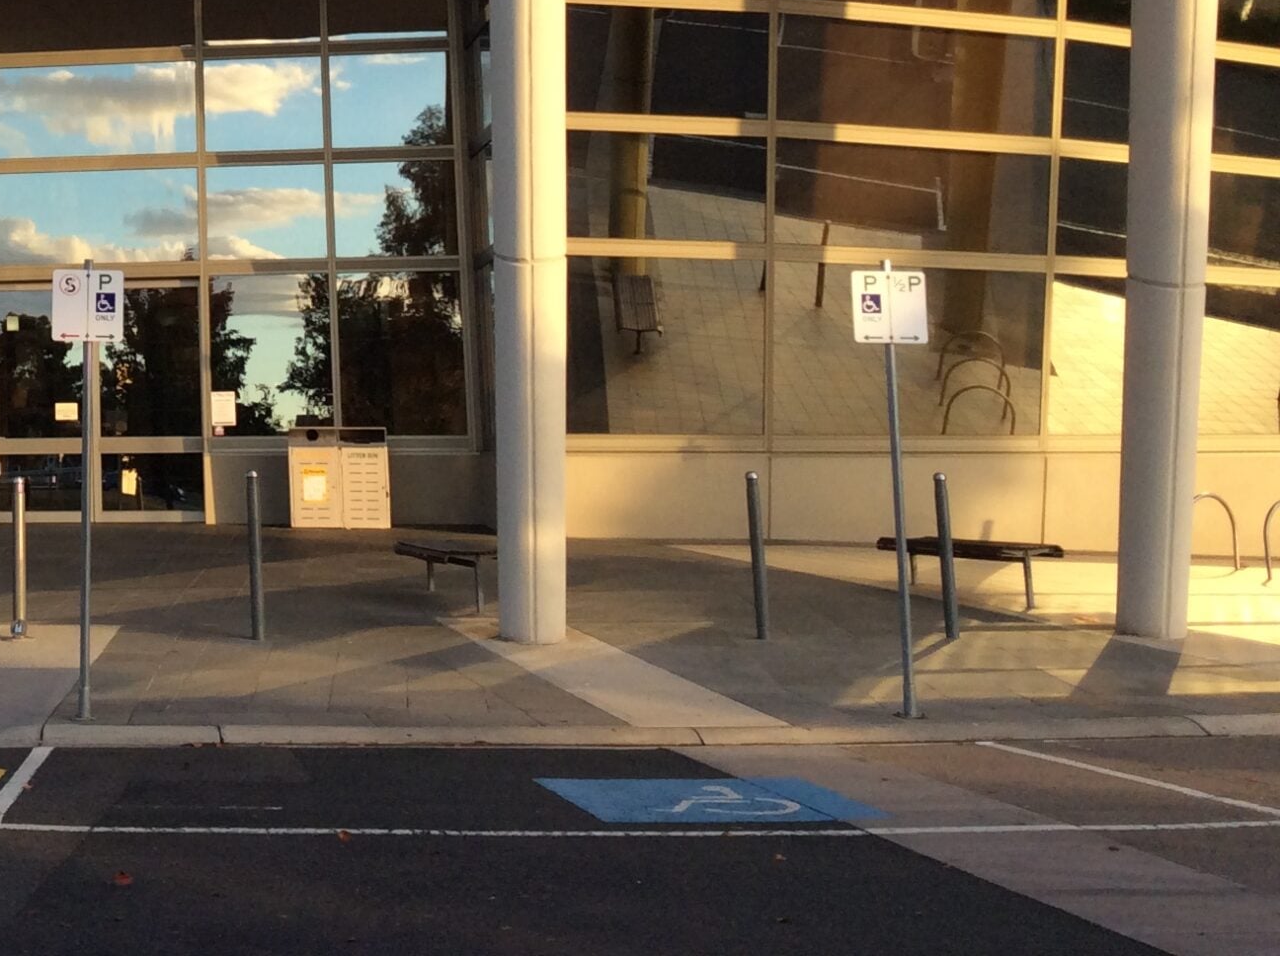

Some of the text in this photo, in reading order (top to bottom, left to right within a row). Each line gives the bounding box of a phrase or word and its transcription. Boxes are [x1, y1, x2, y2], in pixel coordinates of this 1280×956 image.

[99, 274, 112, 291] P
[864, 275, 877, 292] P
[95, 314, 116, 322] ONLY
